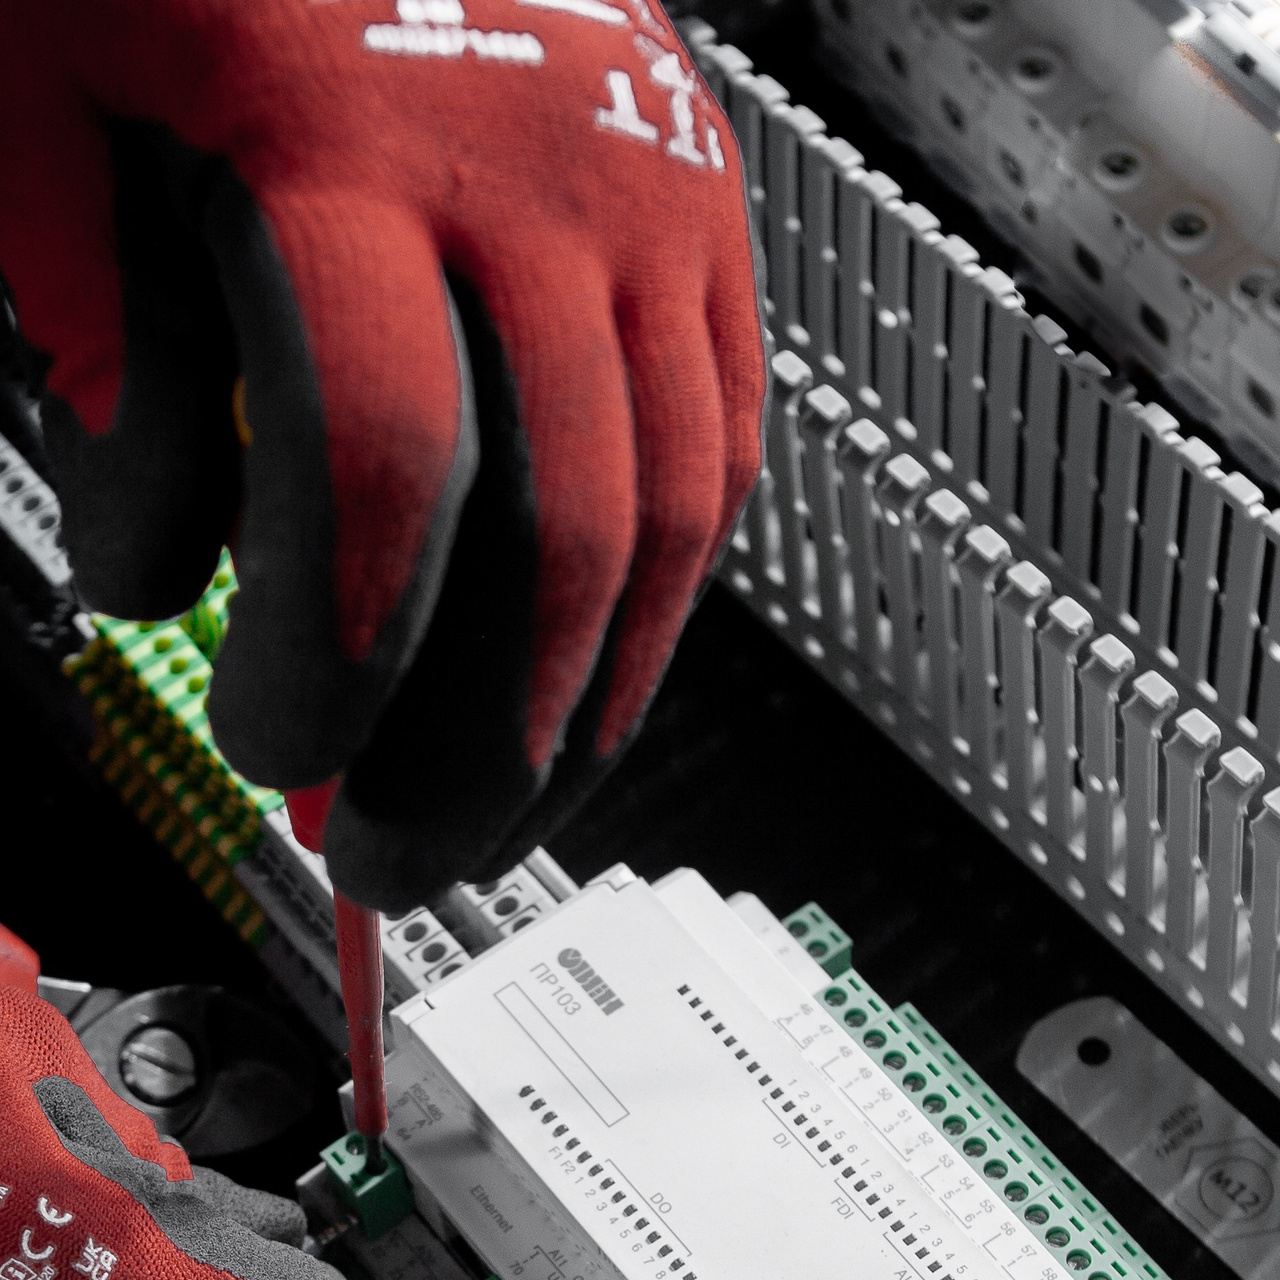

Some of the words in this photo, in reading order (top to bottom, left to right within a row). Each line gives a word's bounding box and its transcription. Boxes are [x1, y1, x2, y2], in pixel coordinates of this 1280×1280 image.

[530, 963, 581, 1015] ПР103
[772, 1132, 791, 1149] DI
[798, 1091, 810, 1100] 2
[810, 1104, 822, 1113] 3
[834, 1130, 846, 1140] 5
[847, 1144, 858, 1153] 6
[870, 1171, 883, 1180] 2
[883, 1184, 894, 1194] 3
[919, 1224, 931, 1234] 2
[931, 1237, 943, 1247] 3
[956, 1265, 968, 1274] 5
[470, 1183, 514, 1234] Ethernet
[548, 1145, 563, 1160] F1
[560, 1159, 576, 1175] F2
[584, 1188, 597, 1198] 2
[596, 1202, 608, 1212] 3
[619, 1229, 631, 1239] 5
[631, 1243, 643, 1252] 6
[643, 1256, 655, 1264] 7
[655, 1270, 666, 1280] 8
[649, 1192, 672, 1214] DO
[830, 1196, 855, 1220] FDI
[959, 1176, 975, 1191] 54
[979, 1199, 995, 1213] 55
[1000, 1221, 1016, 1236] 56
[1021, 1244, 1038, 1257] 57
[509, 1260, 524, 1276] 70
[548, 1249, 568, 1267] AI1
